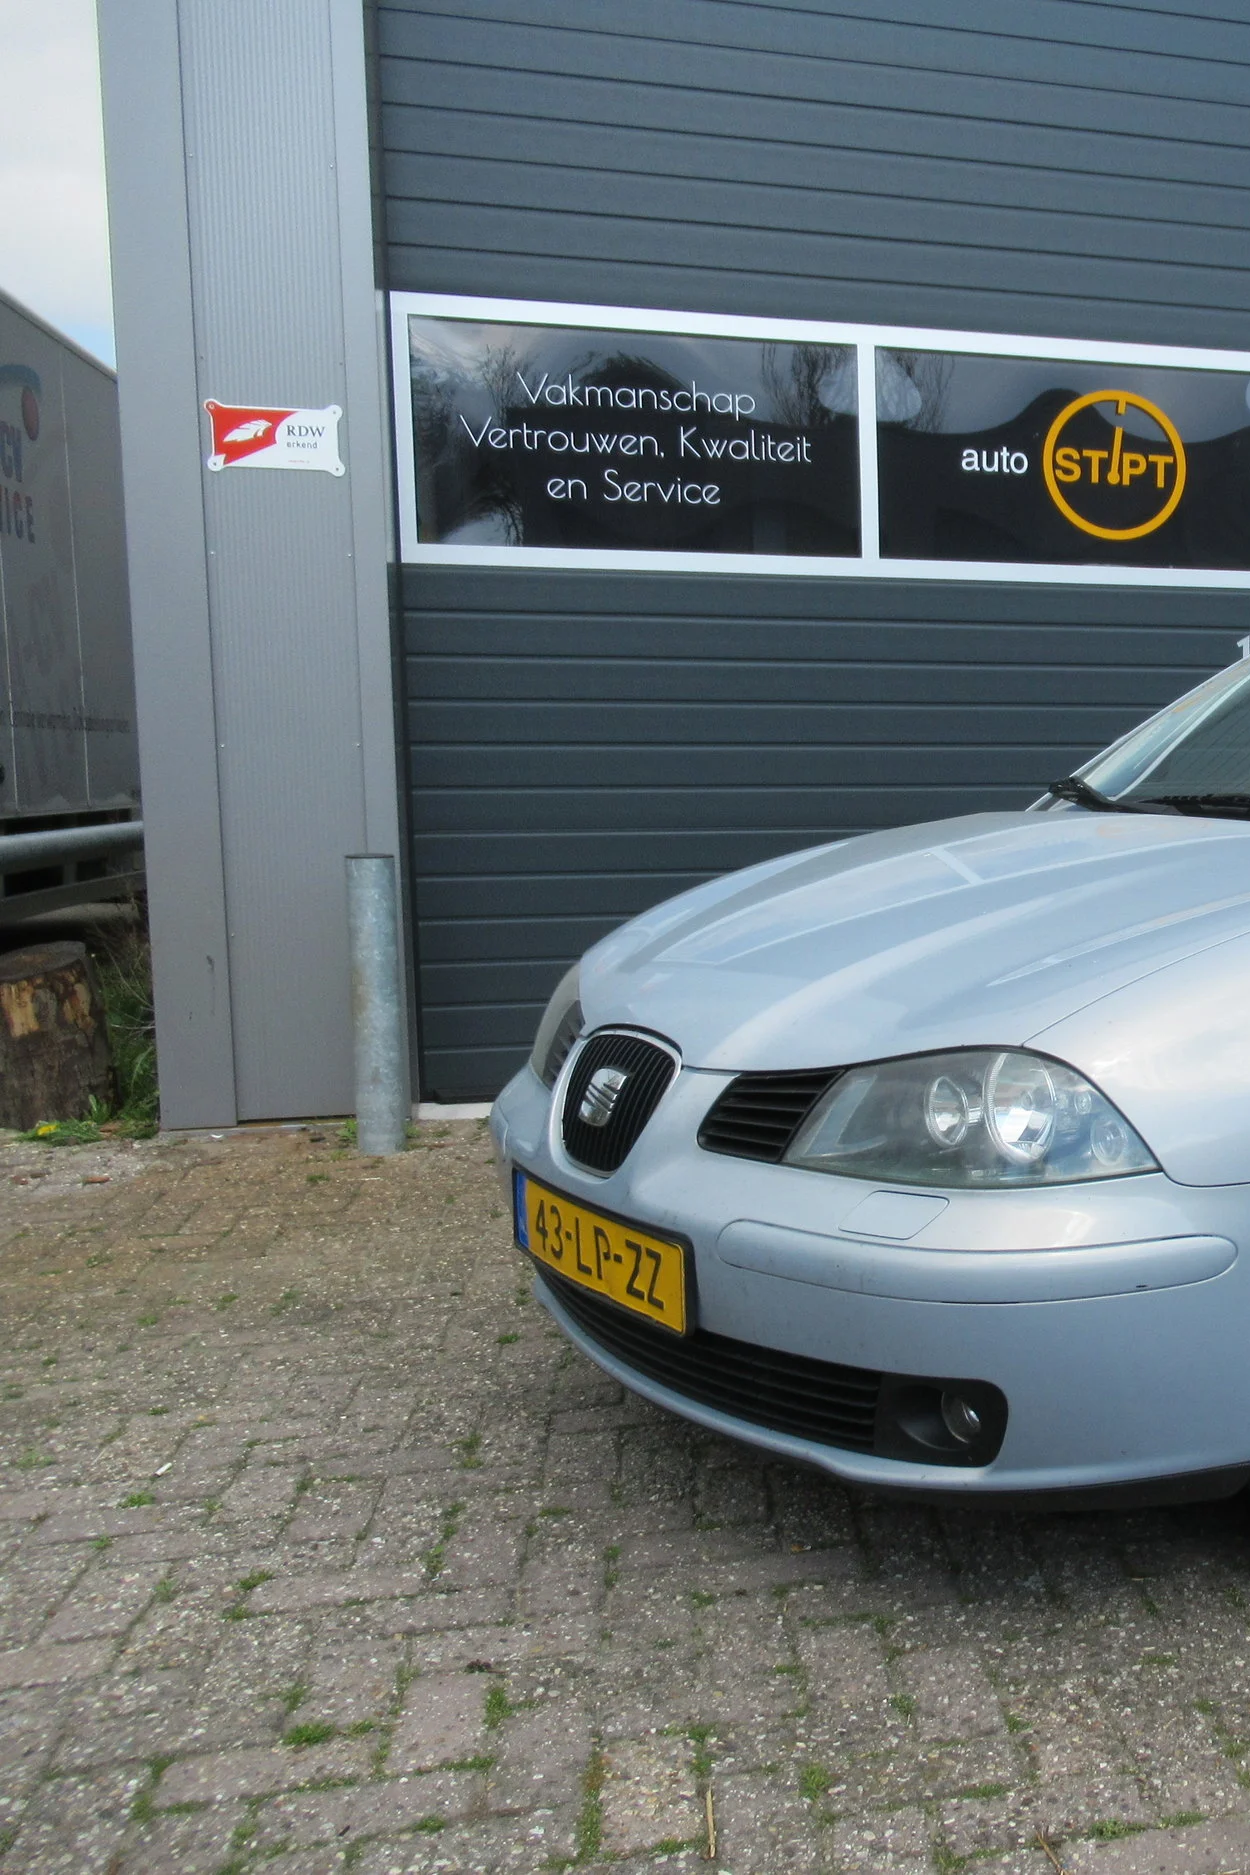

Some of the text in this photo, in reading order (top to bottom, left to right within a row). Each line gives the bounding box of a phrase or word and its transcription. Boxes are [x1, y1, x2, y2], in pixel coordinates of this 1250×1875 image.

[517, 371, 756, 420] Vakmanschap
[286, 424, 325, 438] RDW
[679, 425, 812, 463] Kwaliteit
[961, 446, 1029, 474] auto
[547, 469, 721, 505] en Service
[535, 1199, 665, 1311] 43-LP-ZZ
